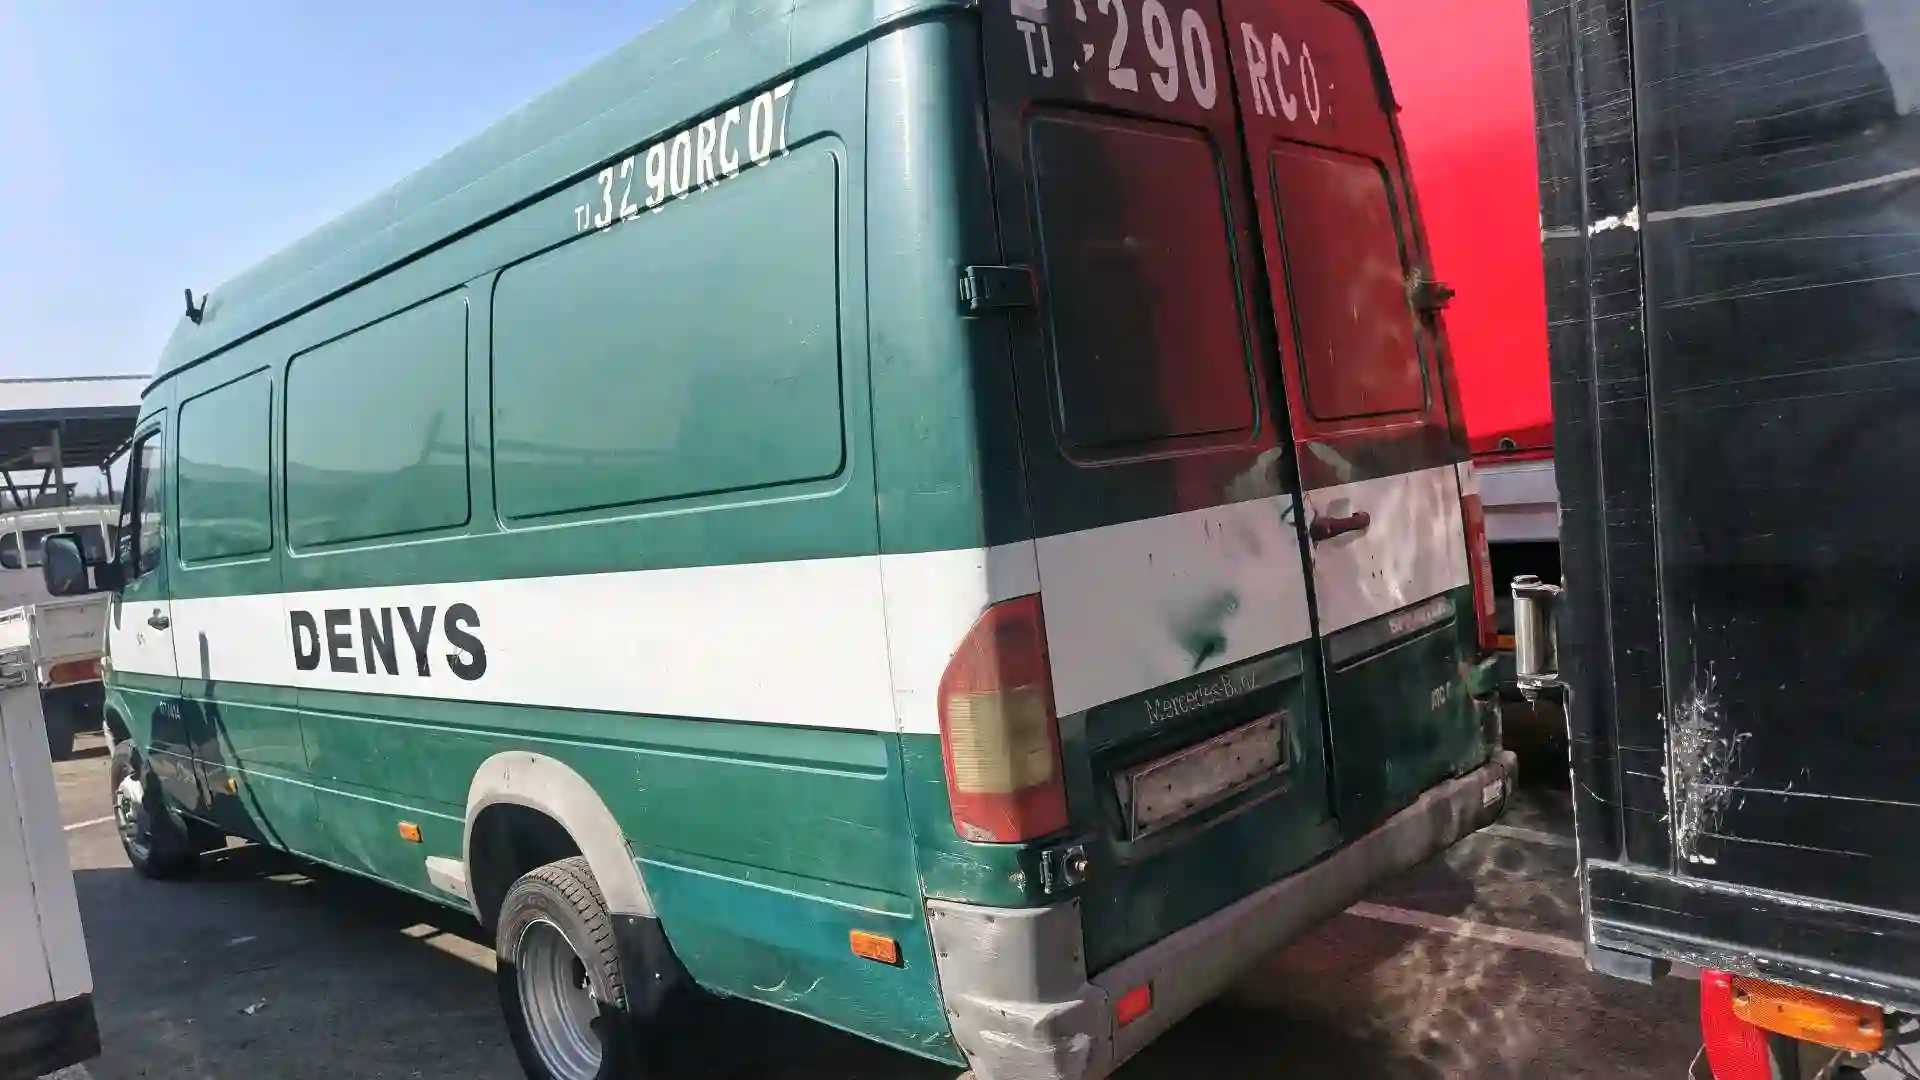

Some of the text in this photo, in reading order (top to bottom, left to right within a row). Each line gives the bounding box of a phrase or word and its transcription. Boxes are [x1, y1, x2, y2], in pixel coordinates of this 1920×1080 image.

[1015, 19, 1054, 78] TJ
[1240, 22, 1335, 126] RC0
[574, 203, 591, 232] TJ
[289, 602, 488, 682] DENYS
